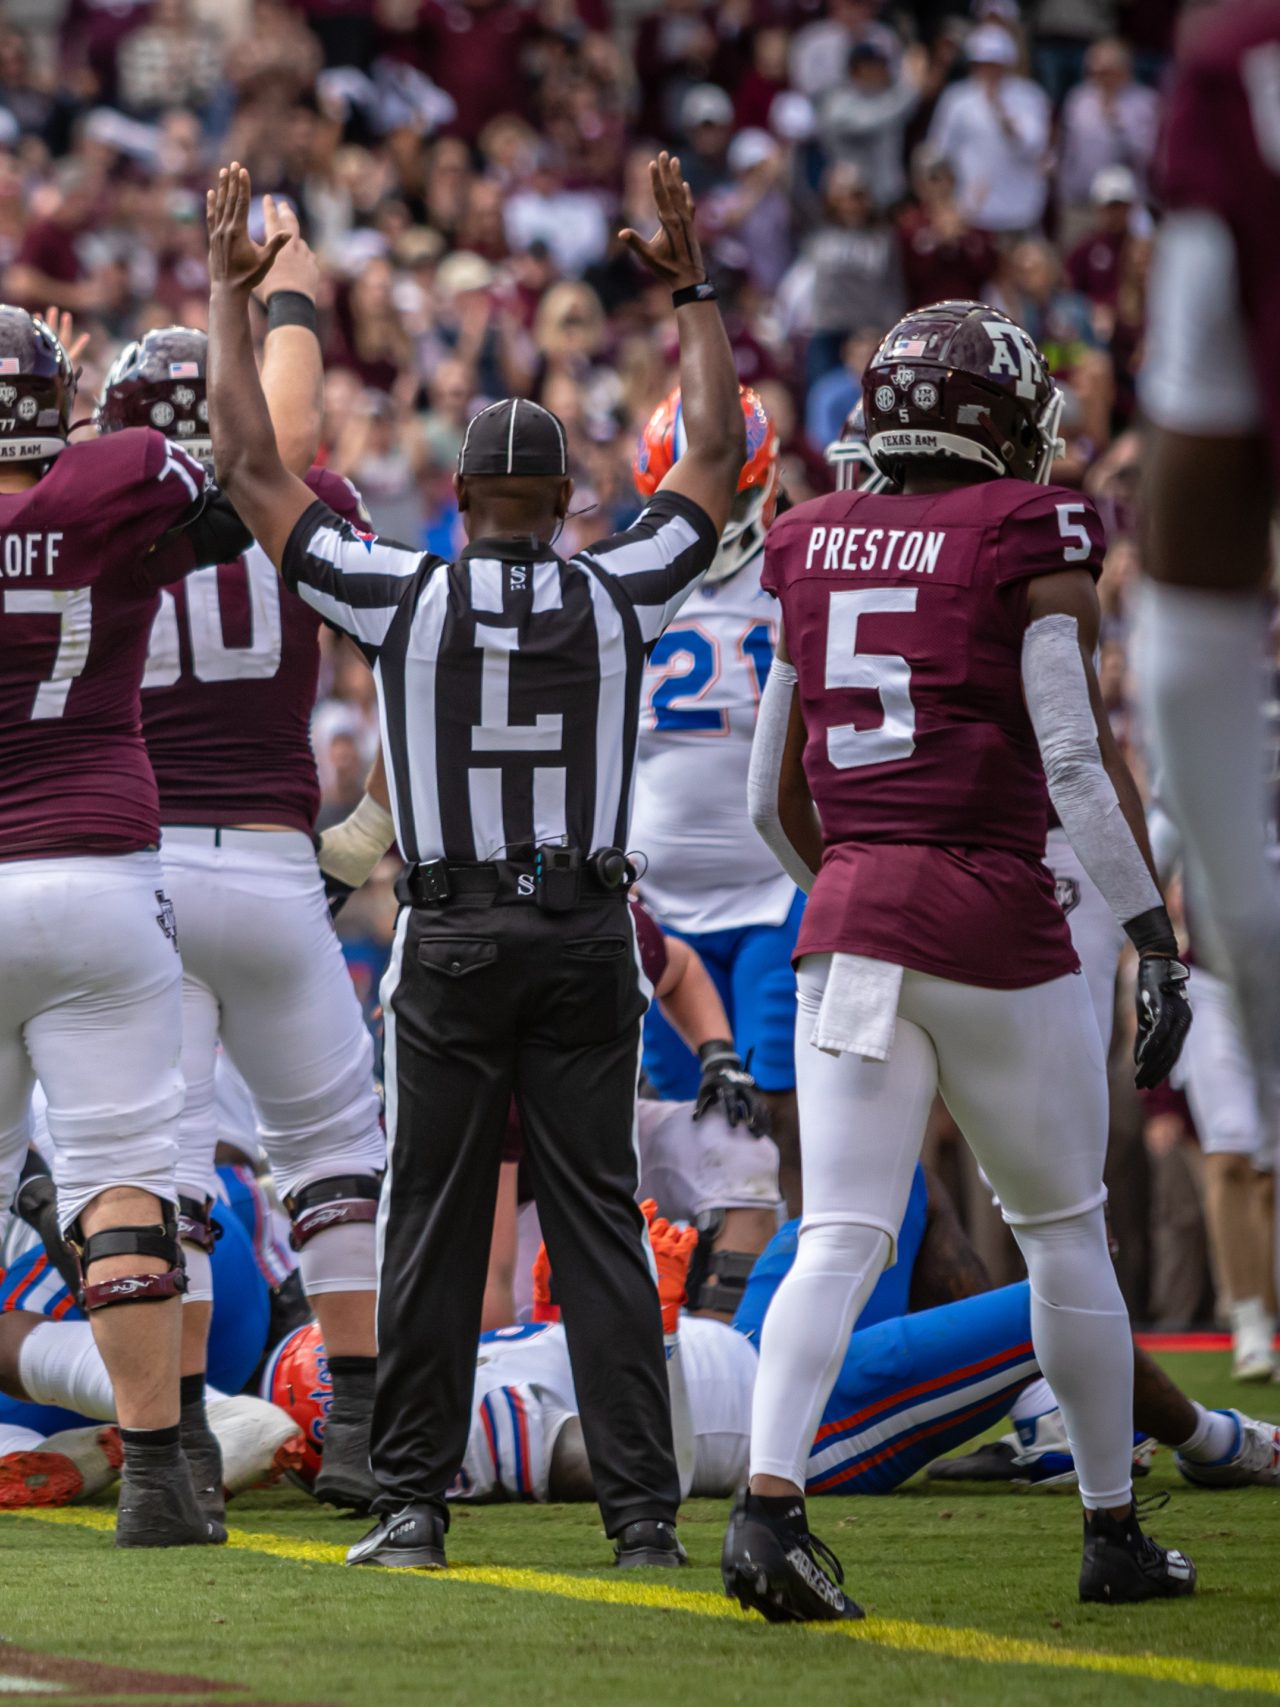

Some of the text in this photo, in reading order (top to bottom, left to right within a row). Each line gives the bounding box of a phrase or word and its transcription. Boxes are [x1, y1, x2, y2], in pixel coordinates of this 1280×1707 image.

[881, 434, 938, 447] TEXAS A&M
[898, 408, 910, 423] 5
[19, 444, 42, 456] A&M
[805, 527, 946, 574] PRESTON
[1054, 503, 1092, 562] 5
[471, 622, 564, 752] L
[645, 617, 780, 737] 21
[825, 587, 919, 770] 5
